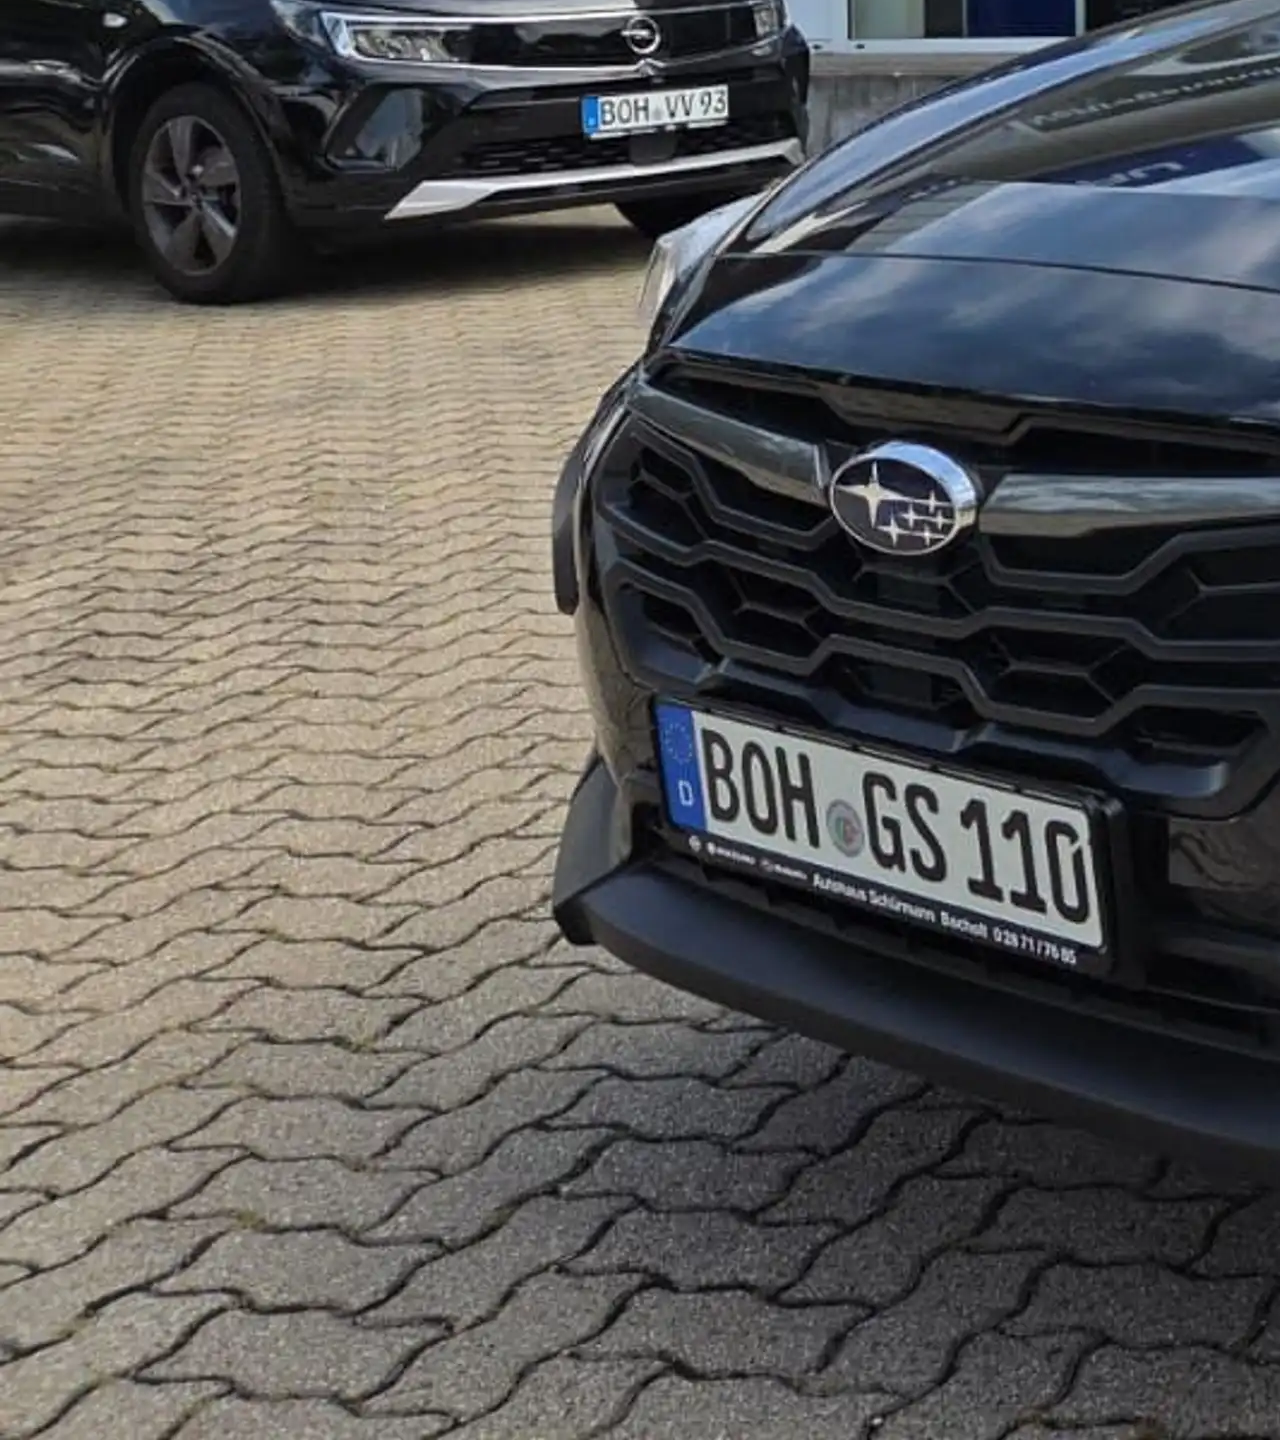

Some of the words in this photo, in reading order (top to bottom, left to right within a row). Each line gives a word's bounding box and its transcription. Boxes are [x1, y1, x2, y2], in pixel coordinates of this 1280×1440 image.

[600, 96, 650, 126] BOH
[665, 93, 695, 119] VV
[700, 89, 727, 116] 93
[677, 779, 694, 808] D
[700, 728, 821, 849] BOH
[862, 771, 947, 883] GS
[959, 799, 1089, 923] 110
